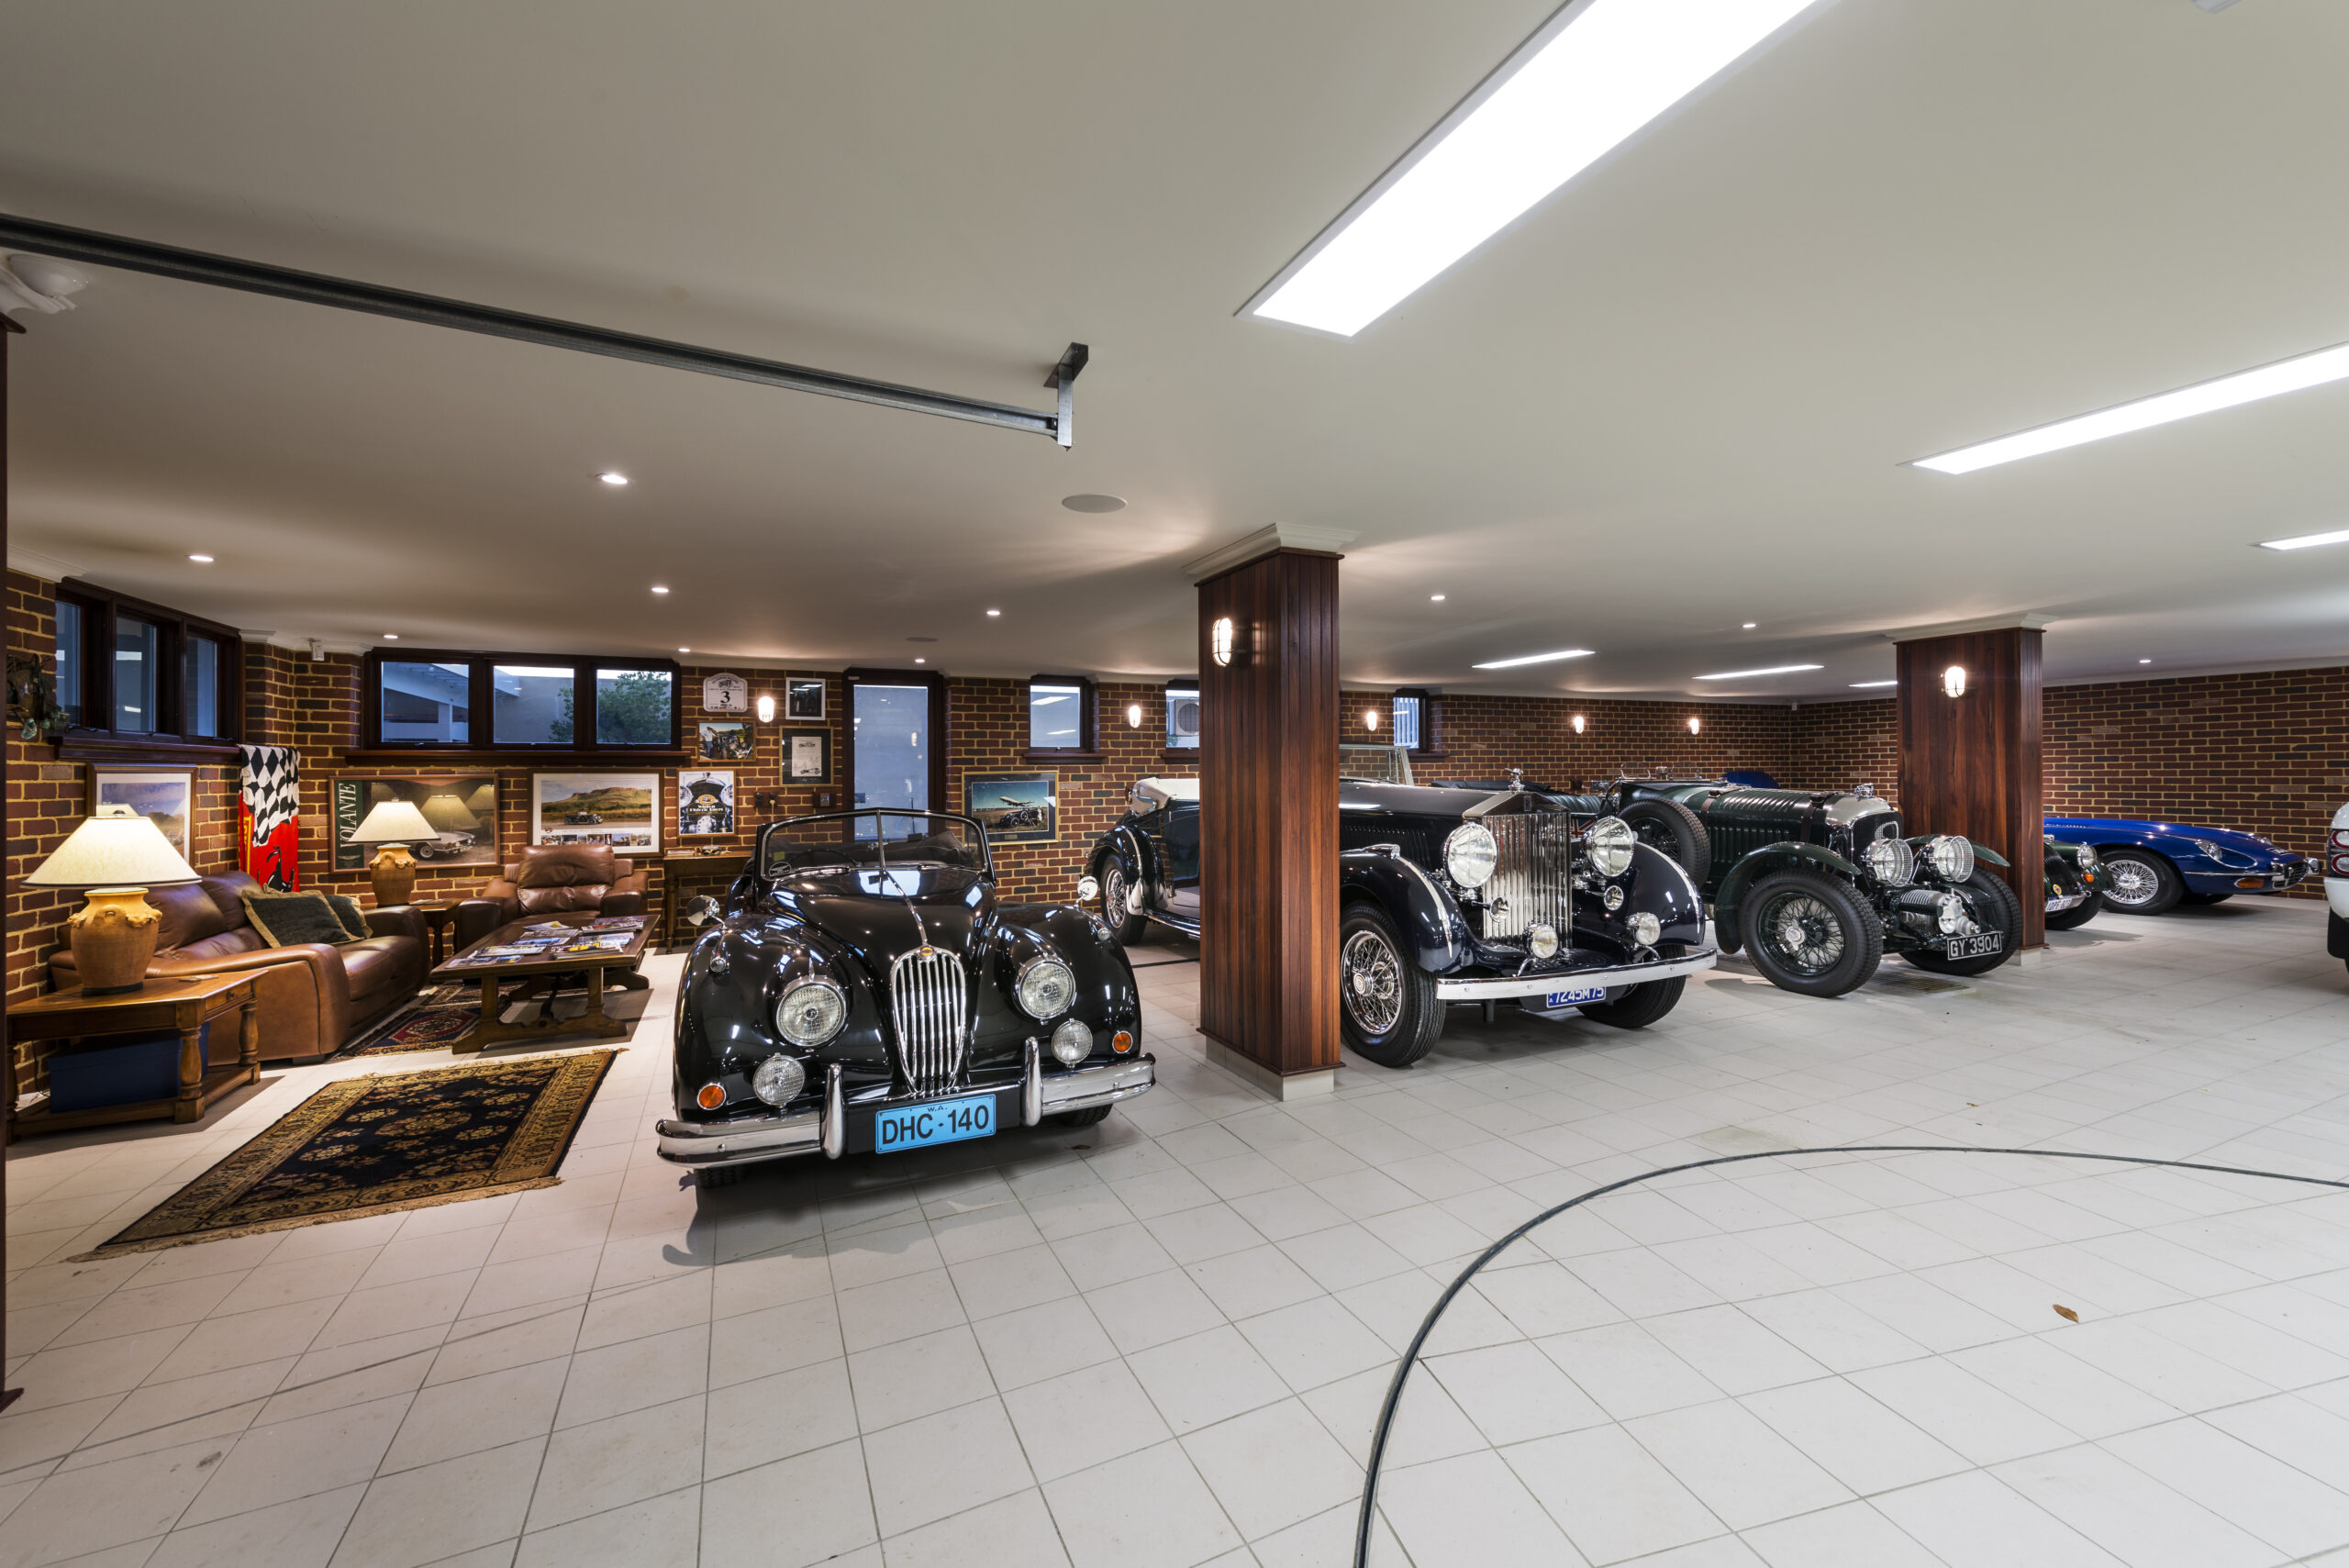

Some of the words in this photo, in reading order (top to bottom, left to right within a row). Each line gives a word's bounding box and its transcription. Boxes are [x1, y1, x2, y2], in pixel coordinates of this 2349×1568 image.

[720, 691, 730, 704] 3
[1950, 939, 1965, 958] GY
[1969, 934, 1999, 954] 3904
[947, 1105, 989, 1134] 140
